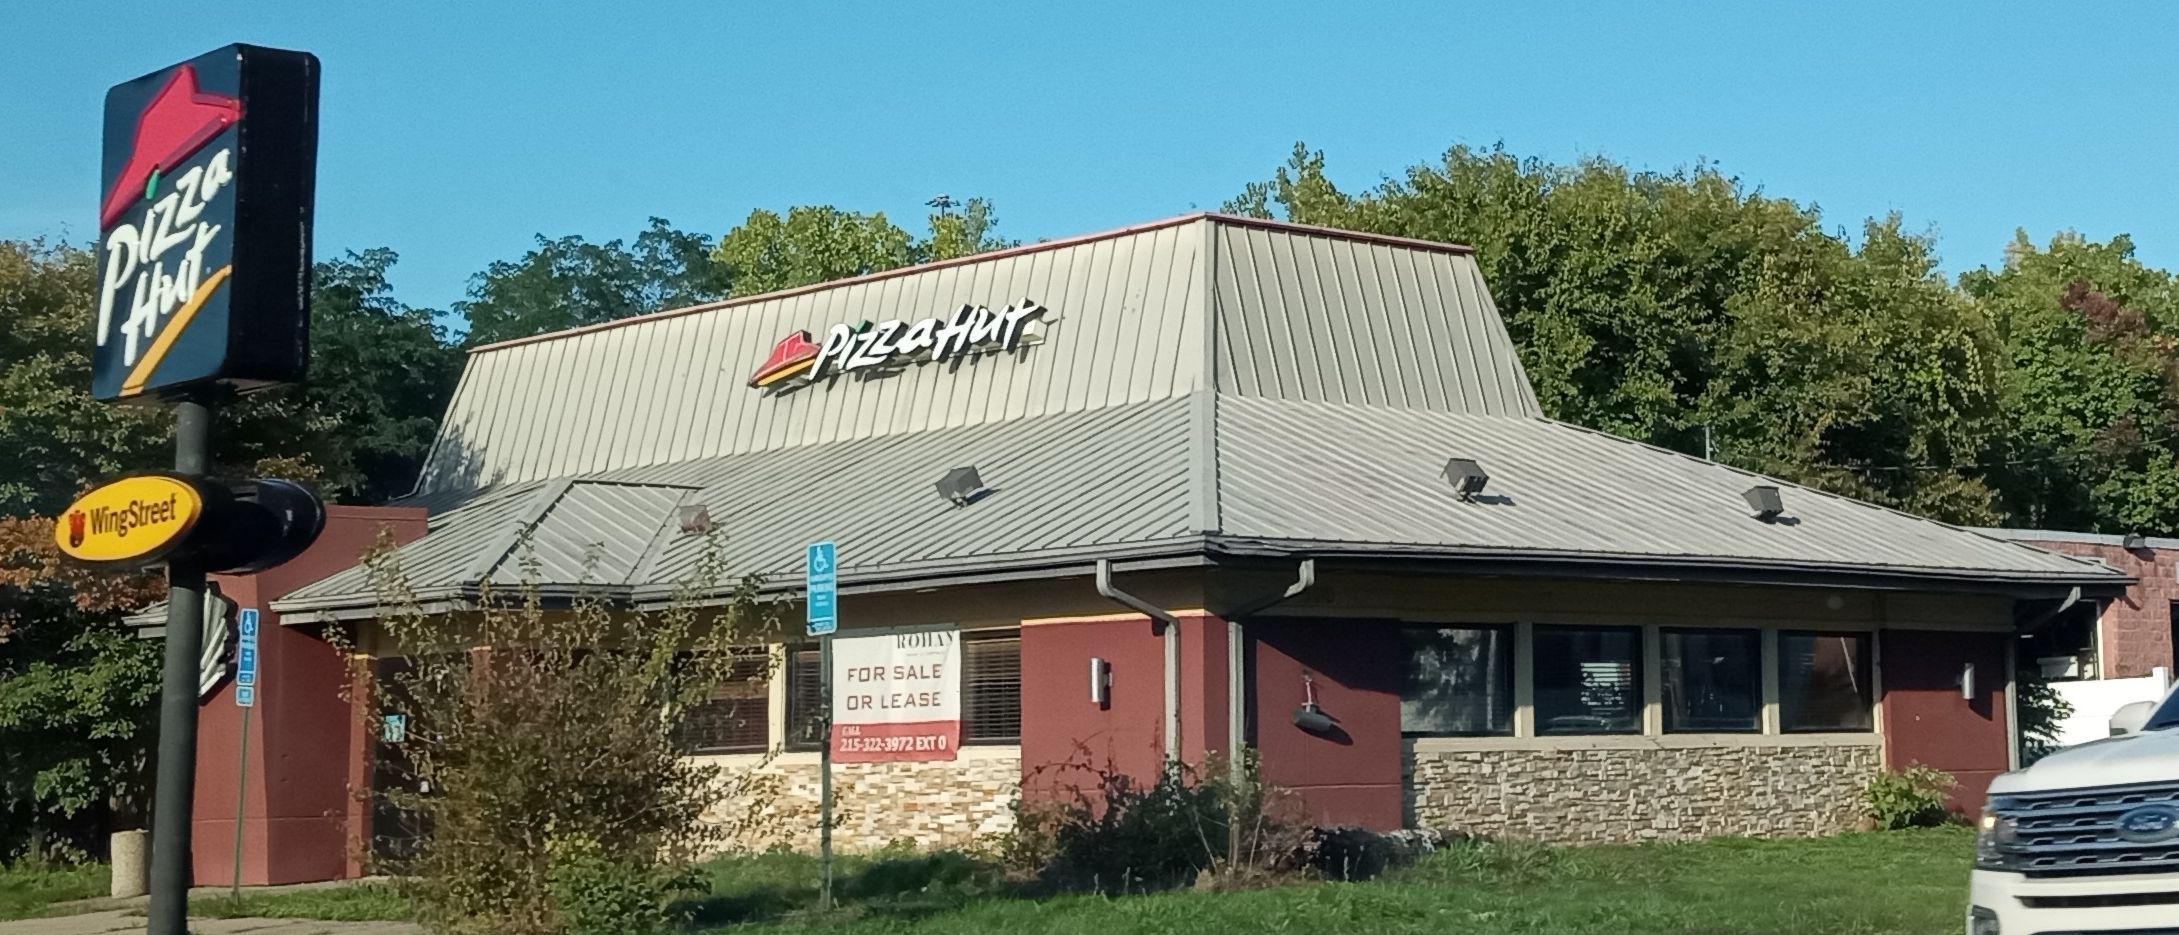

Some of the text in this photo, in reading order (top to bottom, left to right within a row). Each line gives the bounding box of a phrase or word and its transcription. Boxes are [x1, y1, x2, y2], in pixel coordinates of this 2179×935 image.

[97, 148, 233, 346] Pizza
[120, 221, 221, 367] Hut
[808, 297, 1041, 381] Pizza Hut
[90, 492, 177, 537] WingStreet
[847, 664, 942, 682] FOR SALE
[847, 691, 942, 711] OR LEASE
[915, 735, 937, 751] EXT
